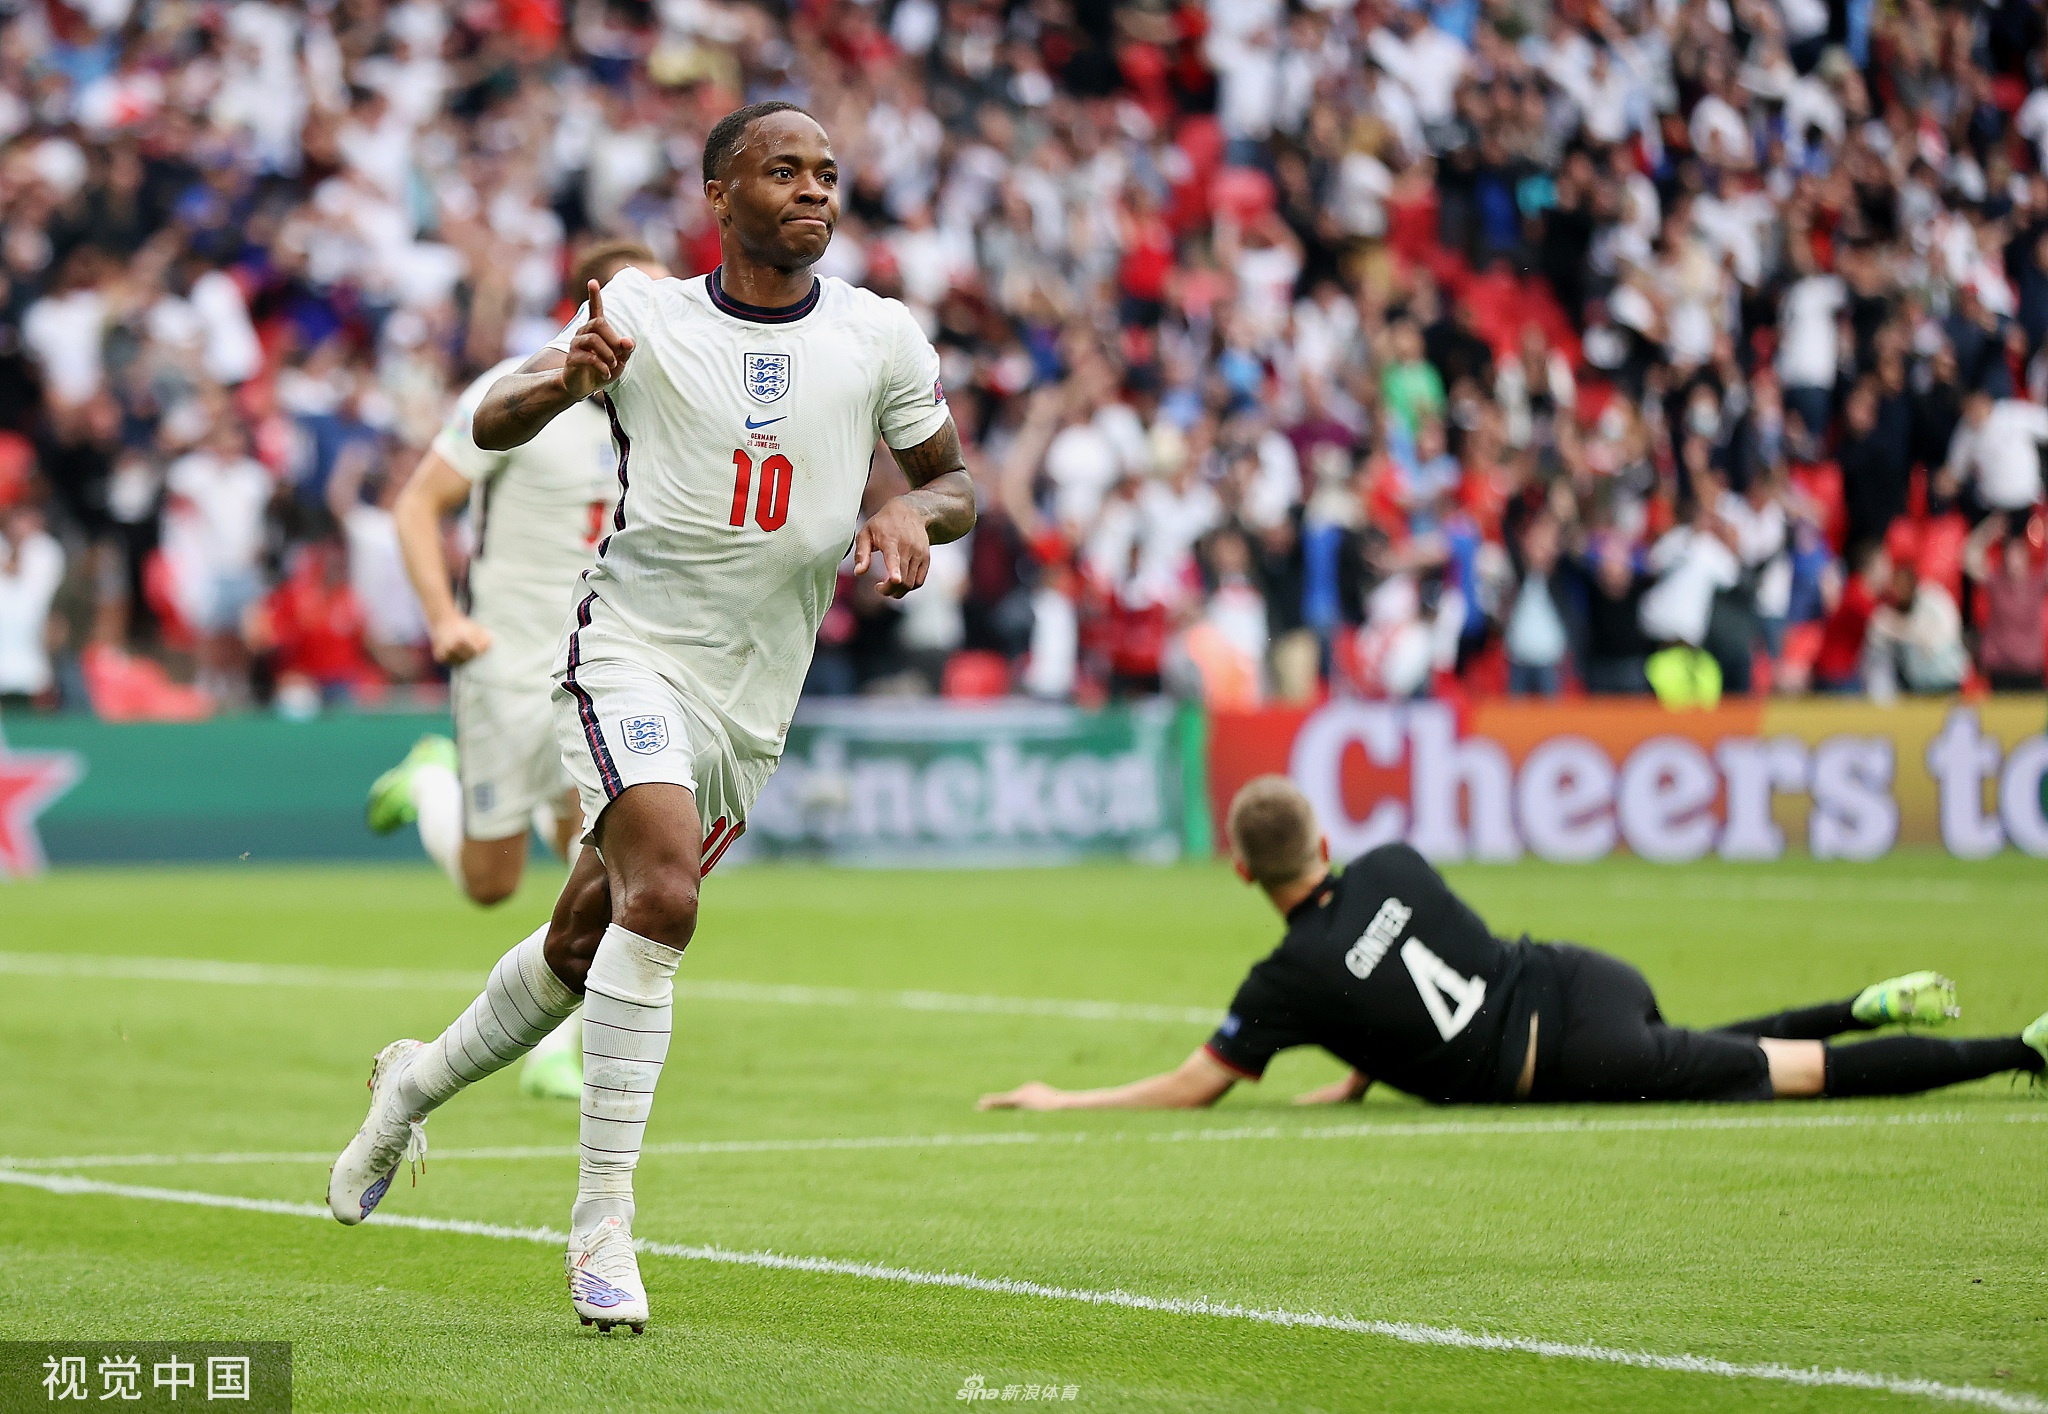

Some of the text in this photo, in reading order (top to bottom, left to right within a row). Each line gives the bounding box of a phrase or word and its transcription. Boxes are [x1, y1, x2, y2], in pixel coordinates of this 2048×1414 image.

[751, 432, 777, 442] GERMANY
[754, 440, 768, 449] JUNE
[768, 442, 780, 450] 2021
[729, 448, 794, 533] 10
[1288, 698, 1898, 863] Cheers
[1344, 897, 1413, 980] GINTER
[1400, 935, 1487, 1043] 4
